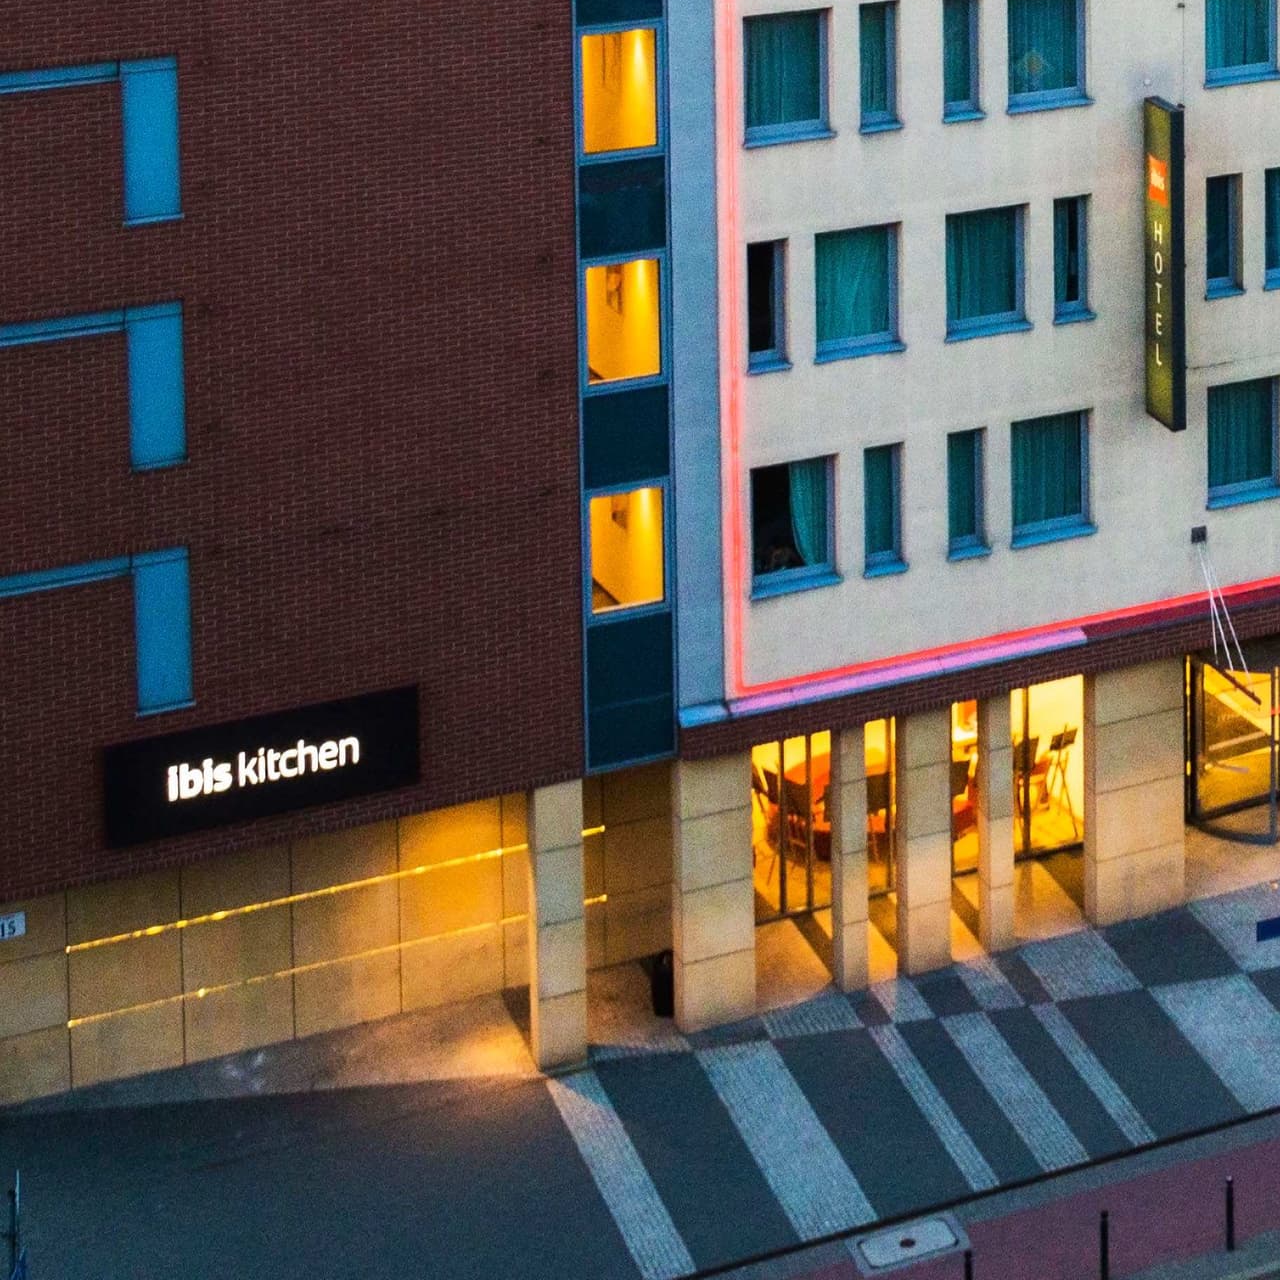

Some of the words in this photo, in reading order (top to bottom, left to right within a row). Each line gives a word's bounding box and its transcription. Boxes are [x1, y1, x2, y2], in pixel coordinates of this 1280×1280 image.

[1153, 220, 1163, 368] HOTEL
[167, 758, 233, 802] ibis
[237, 735, 360, 788] kitchen
